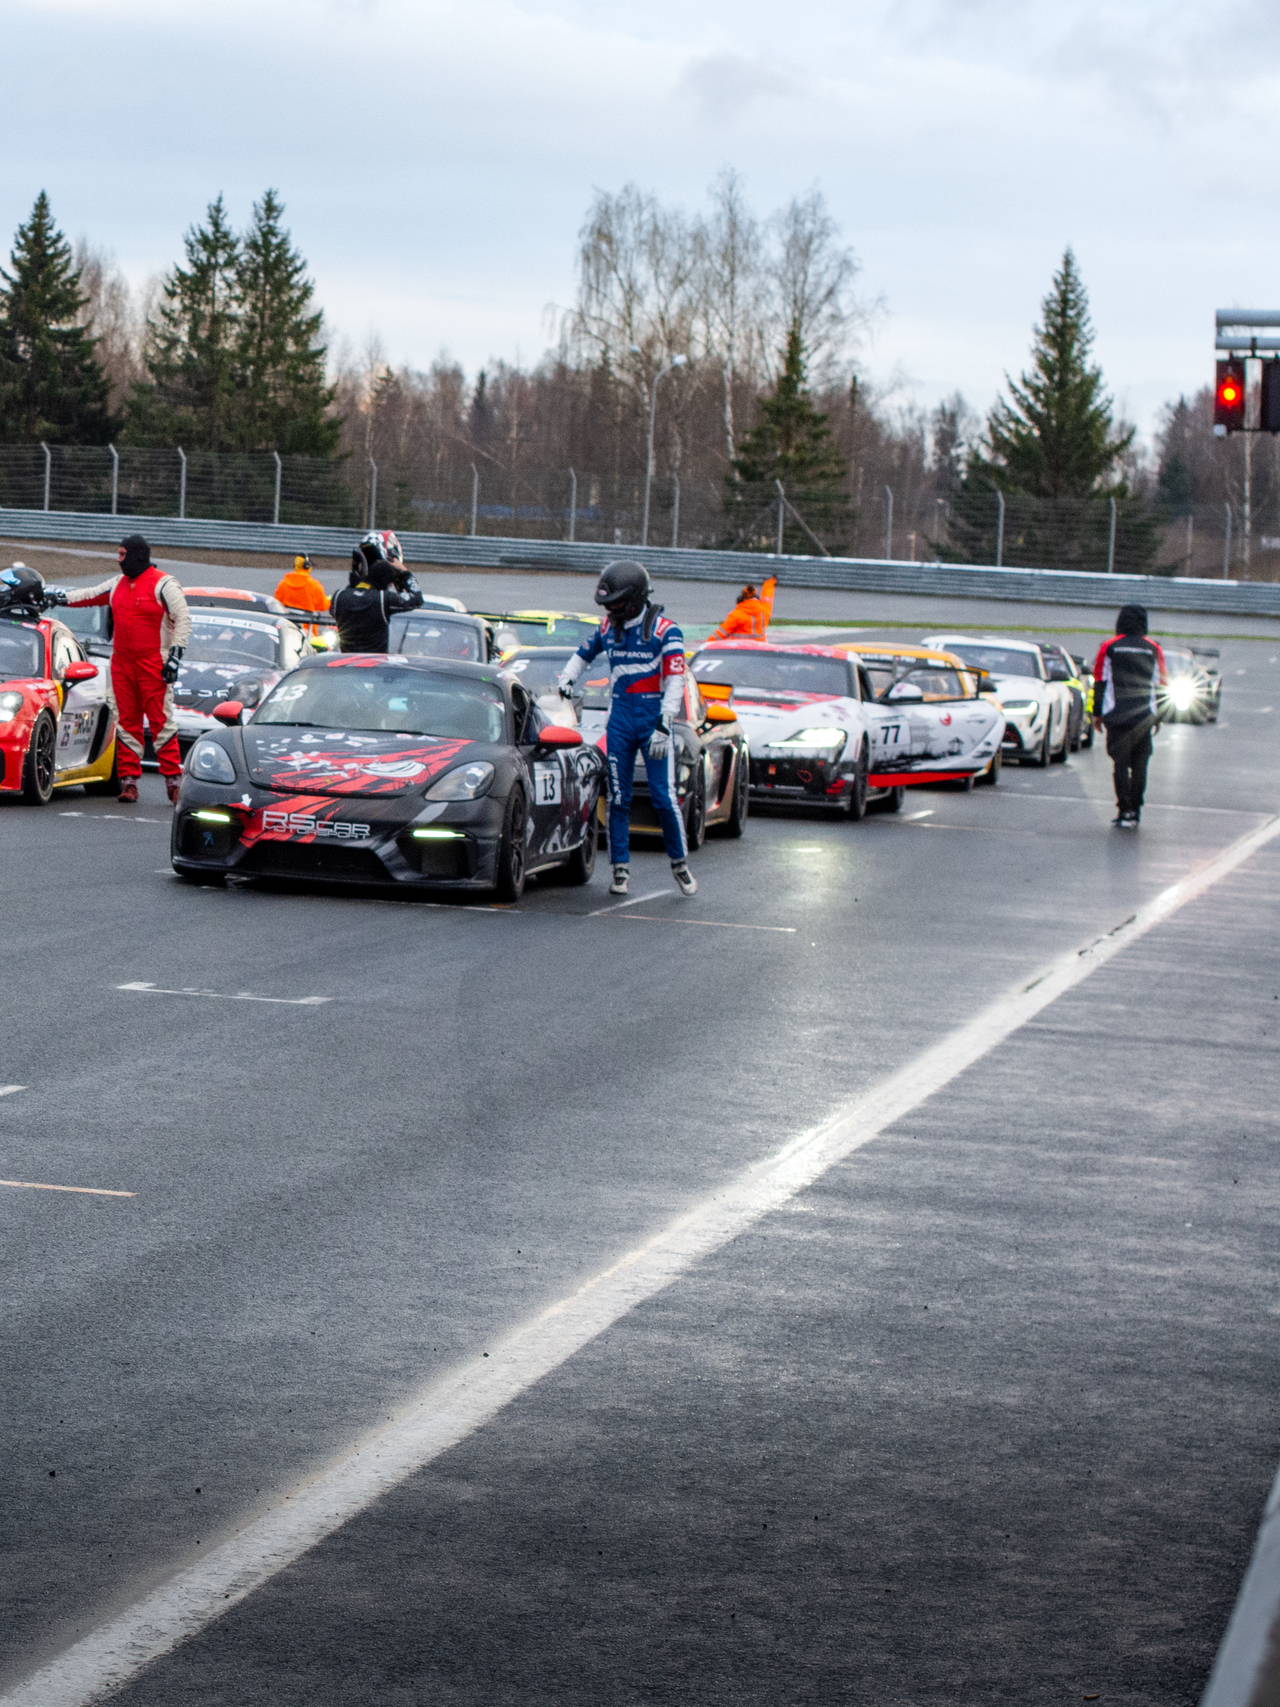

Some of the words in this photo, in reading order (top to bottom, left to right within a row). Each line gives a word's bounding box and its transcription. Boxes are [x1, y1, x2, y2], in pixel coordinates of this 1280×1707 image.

[627, 651, 654, 659] RACING
[692, 660, 723, 672] 77
[269, 684, 308, 703] 13
[880, 724, 901, 745] 77
[542, 773, 556, 801] 13
